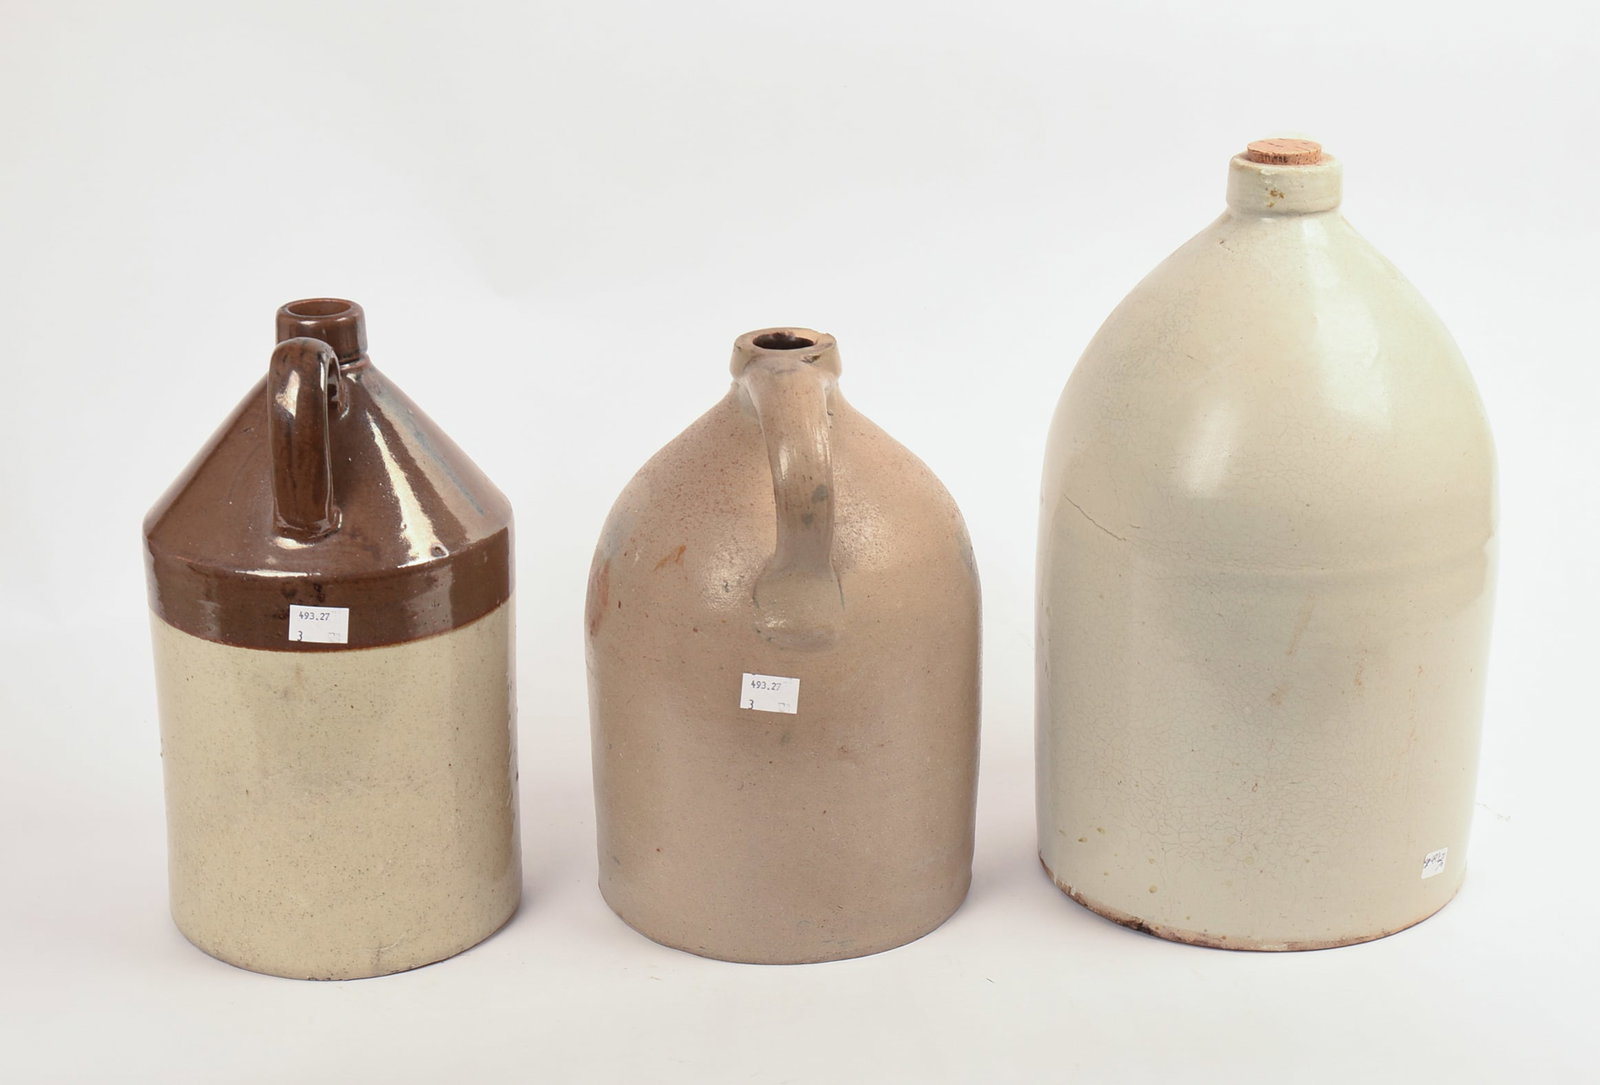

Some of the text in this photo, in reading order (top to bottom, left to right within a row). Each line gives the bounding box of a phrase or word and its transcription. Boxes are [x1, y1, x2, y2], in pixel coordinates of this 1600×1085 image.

[299, 611, 330, 621] 493.27
[297, 630, 303, 641] 3
[751, 680, 781, 691] 493.27
